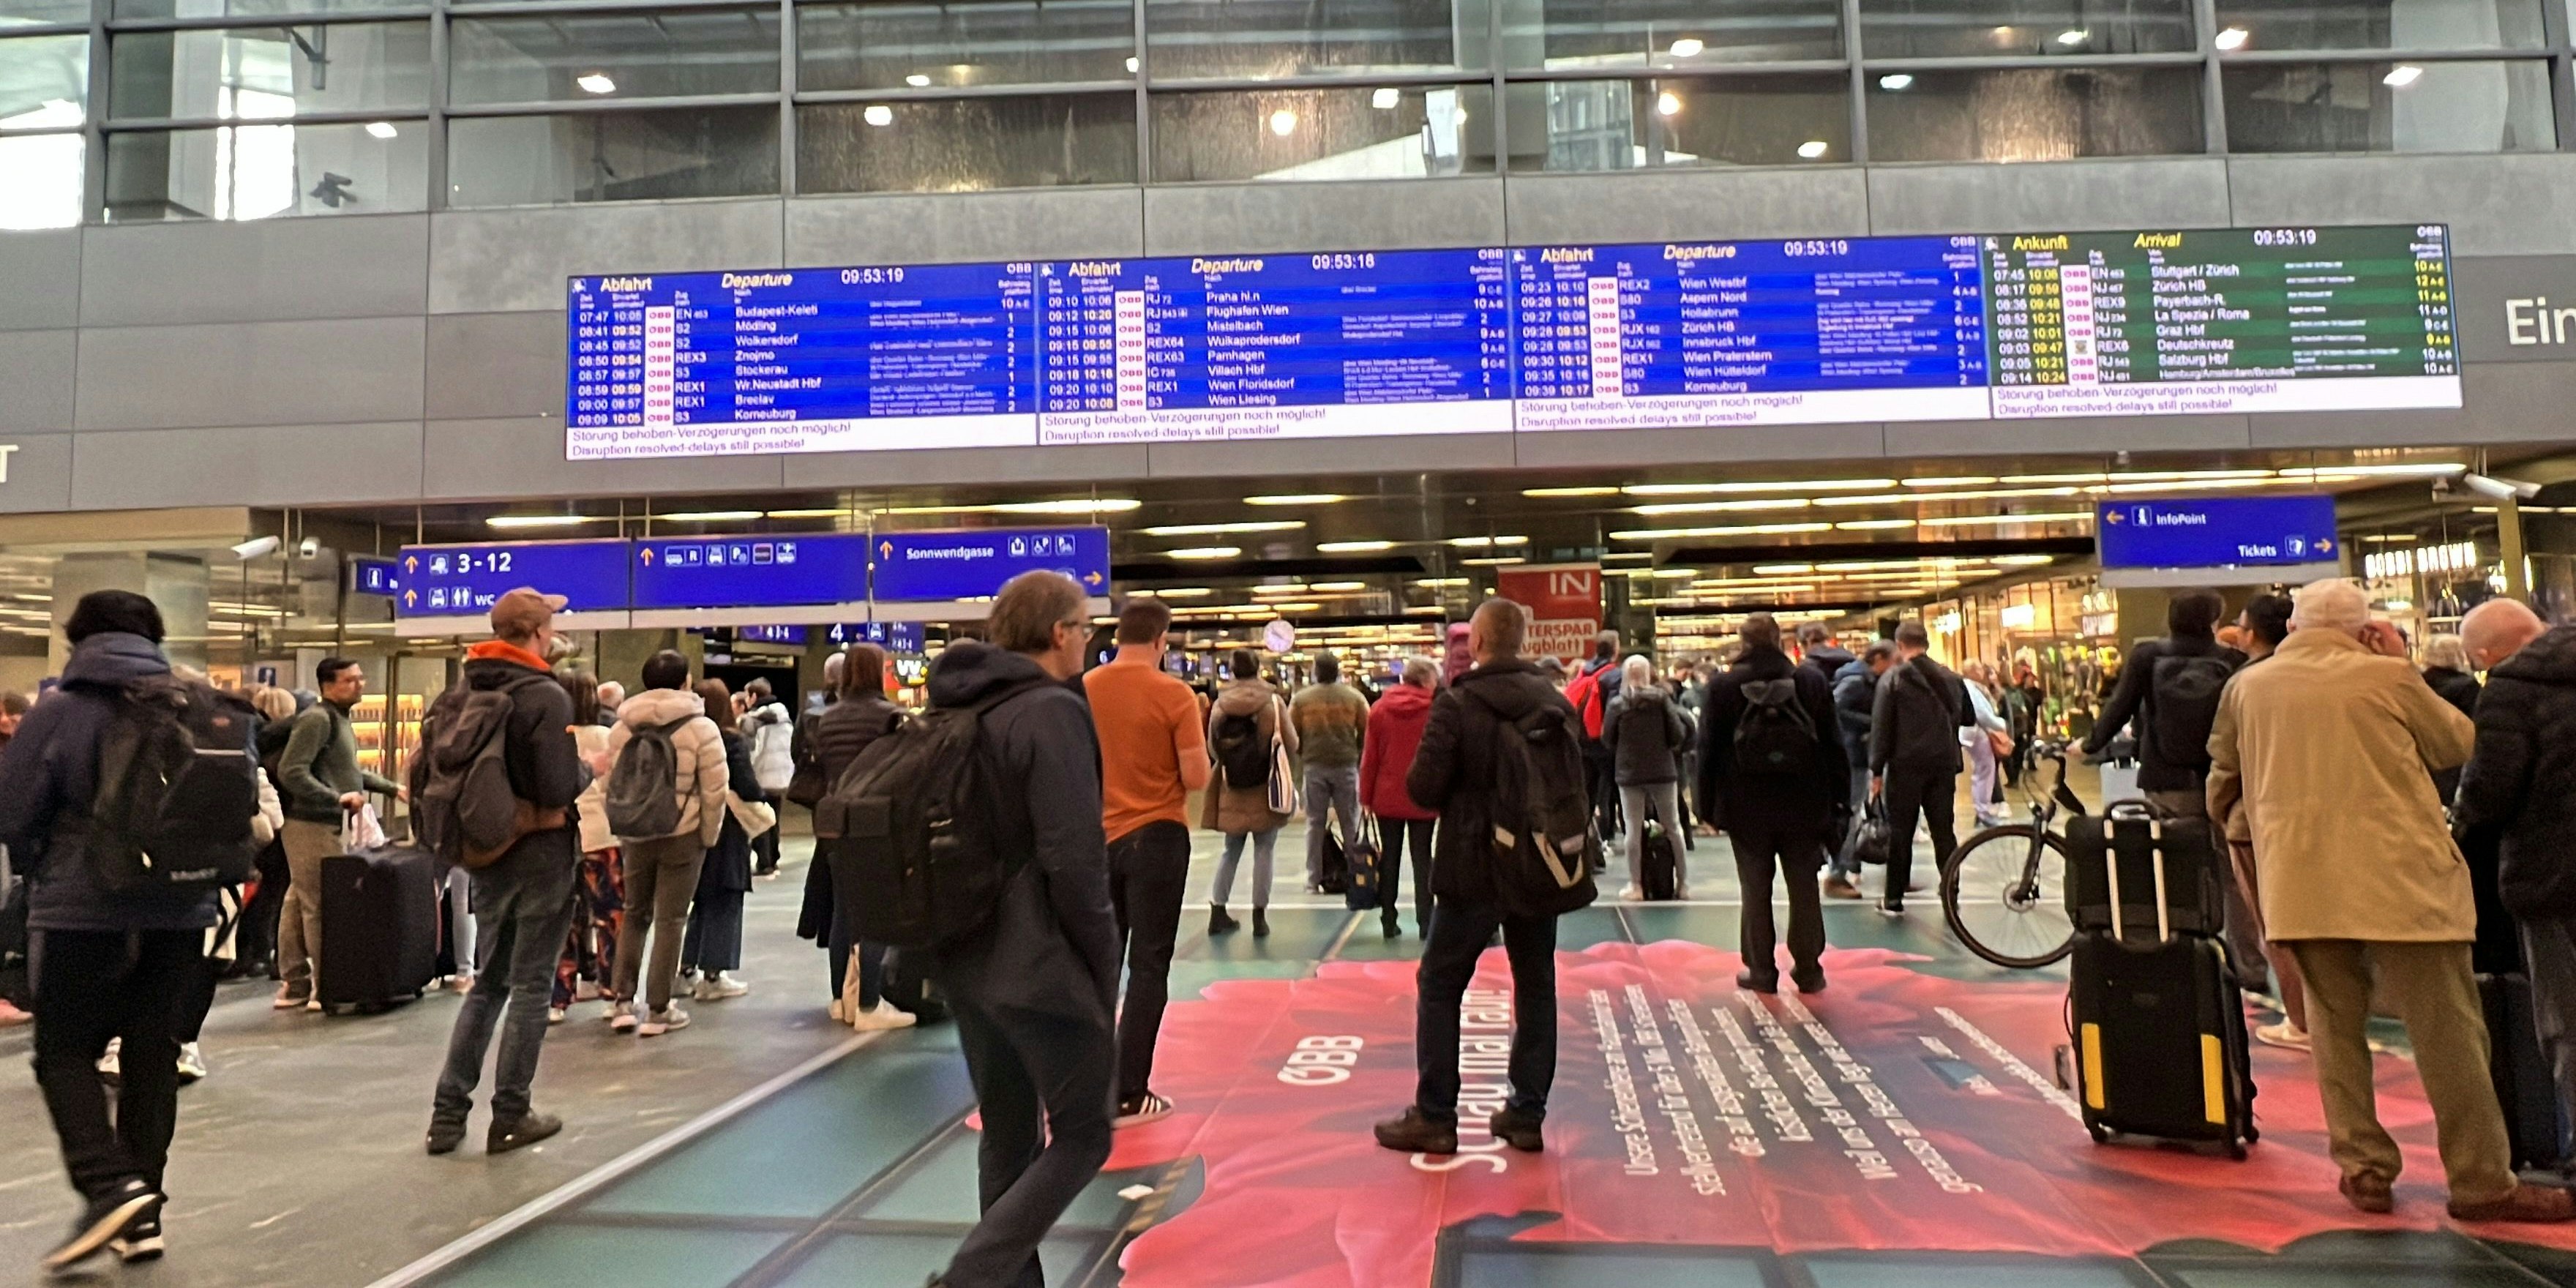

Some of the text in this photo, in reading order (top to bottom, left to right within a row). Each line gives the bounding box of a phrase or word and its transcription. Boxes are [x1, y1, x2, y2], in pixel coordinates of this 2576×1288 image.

[2013, 235, 2067, 252] Ankunft
[2134, 233, 2181, 250] Arrival
[2254, 230, 2316, 245] 09:53:19
[1664, 245, 1736, 261] Departure
[1785, 240, 1847, 256] 09:53:19
[1312, 253, 1374, 269] 09:53:18
[1541, 248, 1593, 263] Abfahrt
[1068, 262, 1120, 277] Abfahrt
[1191, 258, 1263, 274] Departure
[842, 268, 903, 284] 09:53:19
[2152, 266, 2198, 282] Stuttgart
[2206, 264, 2239, 276] Zürich
[601, 277, 651, 291] Abfahrt
[722, 274, 793, 289] Departure
[1620, 280, 1650, 291] REX2
[1680, 277, 1747, 288] Wien Westbf
[2153, 278, 2206, 292] Zürich HB
[1207, 292, 1238, 302] Praha
[1721, 292, 1747, 302] Nord
[580, 311, 608, 323] 07:47
[674, 309, 692, 319] EN
[736, 305, 817, 318] Budapest-Keleti
[1207, 304, 1289, 318] Flughafen Wien
[1682, 307, 1738, 318] Hollabrunn
[2154, 310, 2169, 321] La
[2171, 310, 2209, 326] Spezia
[2217, 308, 2250, 320] Roma
[736, 321, 776, 332] Mödling
[1208, 321, 1262, 332] Mistelbach
[2506, 297, 2576, 344] Ein
[1620, 324, 1644, 334] RJX
[1682, 321, 1734, 334] Zürich HB
[2157, 324, 2204, 336] Graz Hbf
[735, 334, 798, 346] Wolkersdorf
[1208, 333, 1300, 347] Wulkaprodersdorf
[1683, 335, 1756, 347] Innsbruck Hbf
[2157, 339, 2234, 351] Deutschkreutz
[735, 351, 775, 362] Znojmo
[1621, 353, 1652, 364] REX1
[1683, 352, 1711, 362] Wien
[2159, 353, 2228, 370] Salzburg Hbf
[736, 365, 787, 376] Stockerau
[1208, 364, 1265, 376] Villach Hbf
[1684, 367, 1712, 377] Wien
[675, 381, 704, 392] REX1
[735, 378, 821, 390] Wr.Neustadt Hbf
[1147, 381, 1177, 392] REX1
[1208, 378, 1294, 390] Wien Floridsdorf
[1685, 381, 1748, 394] Korneuburg
[2195, 381, 2226, 394] noch
[675, 397, 704, 407] REX1
[735, 394, 774, 405] Breclav
[1208, 394, 1278, 407] Wien Liesing
[1719, 394, 1750, 406] noch
[1243, 408, 1273, 419] noch
[1999, 400, 2059, 417] Disruption
[2158, 397, 2176, 410] still
[735, 408, 798, 422] Korneuburg
[1521, 417, 1582, 431] Disruption
[1682, 409, 1701, 422] still
[768, 421, 799, 434] noch
[1044, 431, 1105, 445] Disruption
[1205, 427, 1224, 435] still
[573, 446, 634, 459] Disruption
[730, 441, 749, 450] still
[753, 440, 806, 454] possible!
[2157, 514, 2206, 525] InfoPoint
[907, 547, 994, 560] Sonnwendgasse
[2239, 544, 2277, 557] Tickets
[2416, 542, 2476, 573] BROWN
[1549, 572, 1591, 596] IN
[828, 621, 845, 643] 4
[1527, 622, 1593, 638] TERSPAR
[1521, 637, 1580, 655] ugblatt
[1276, 1036, 1363, 1086] ÖBB
[1843, 1149, 1898, 1180] Weil
